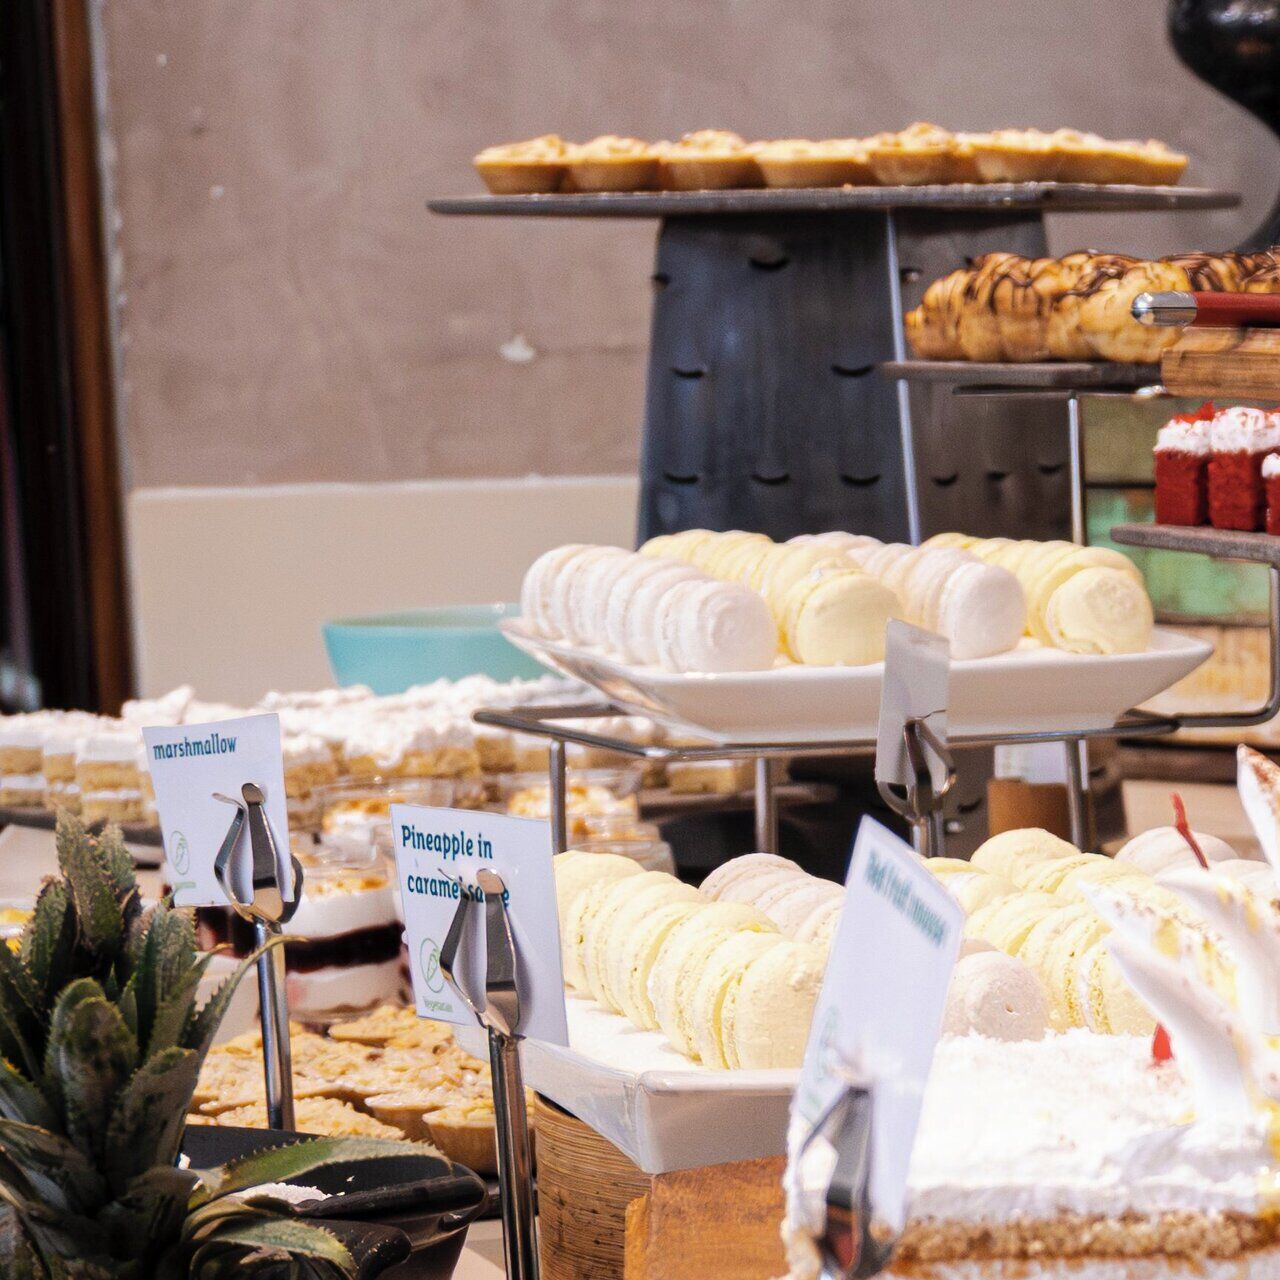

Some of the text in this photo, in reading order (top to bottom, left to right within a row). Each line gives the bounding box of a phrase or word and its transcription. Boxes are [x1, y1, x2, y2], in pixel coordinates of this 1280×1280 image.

[153, 733, 237, 760] marshmallow
[401, 825, 493, 861] Pineapple in
[467, 884, 510, 908] sae
